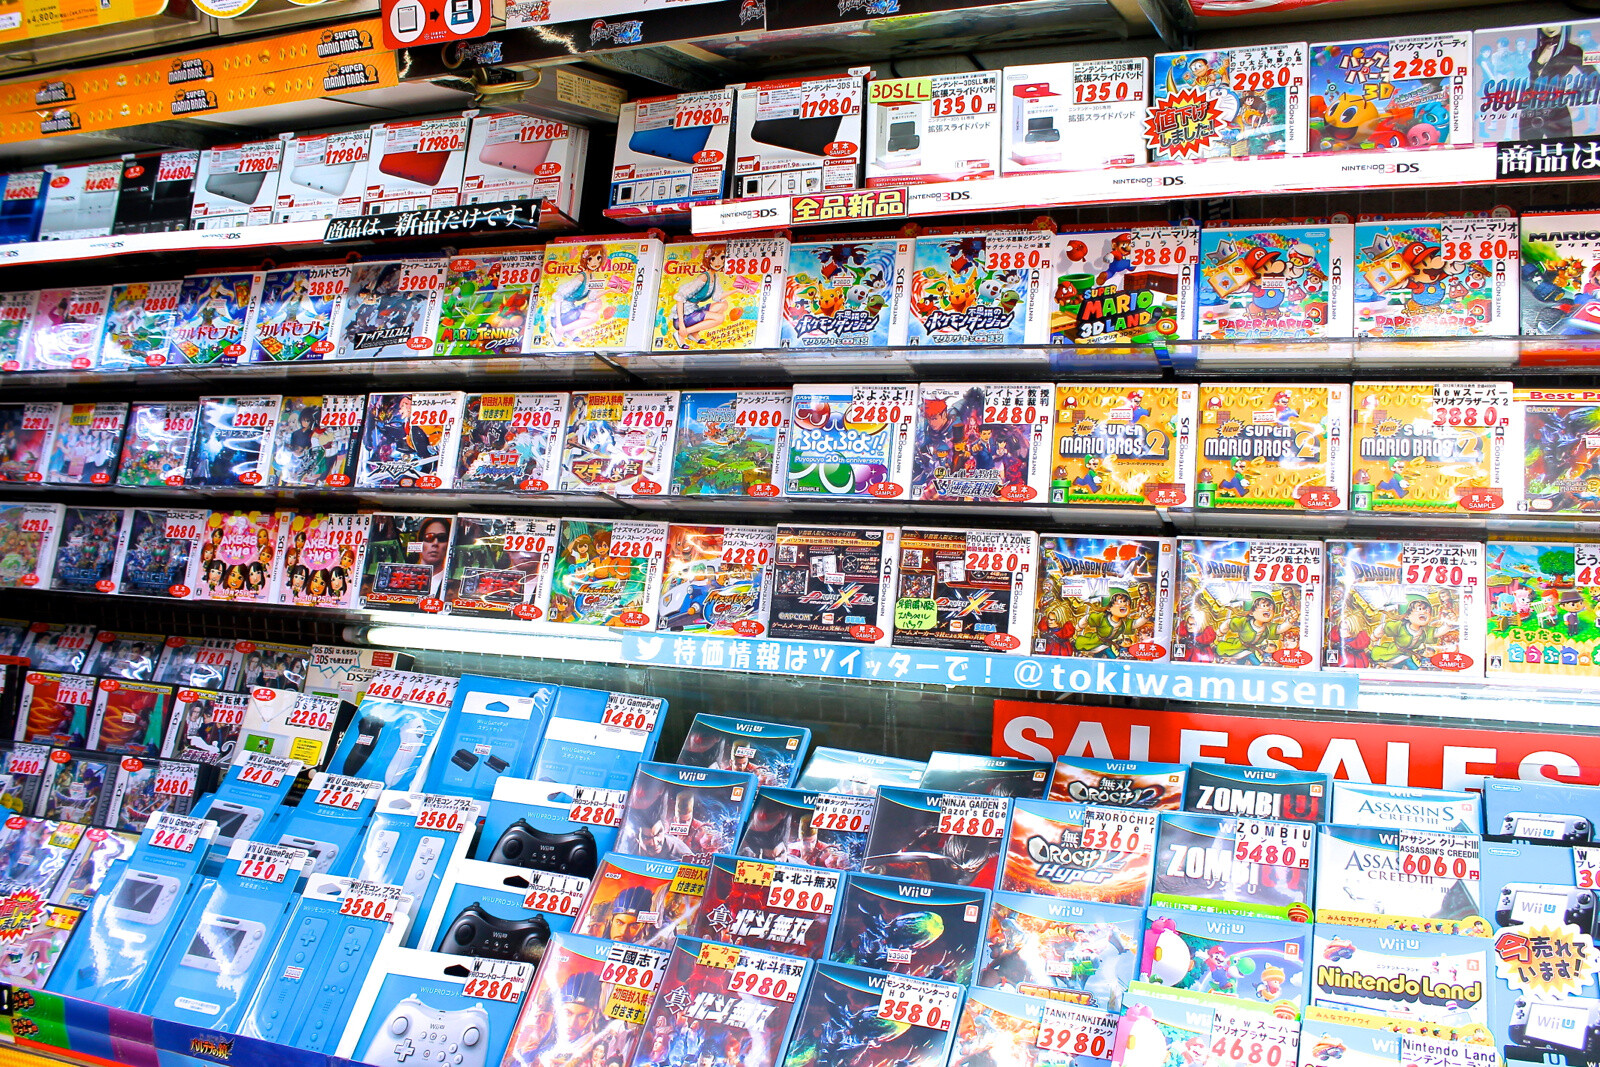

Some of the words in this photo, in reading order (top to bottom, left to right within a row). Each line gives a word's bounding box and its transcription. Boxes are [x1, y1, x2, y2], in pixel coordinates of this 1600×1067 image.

[335, 31, 357, 39] SUPER
[183, 58, 201, 68] SUPER
[341, 64, 363, 72] SUPER
[169, 70, 188, 84] MARIO
[1074, 71, 1143, 83] 拡張スライドパッド
[186, 90, 205, 99] SUPER
[872, 83, 928, 99] 3DSLL
[932, 86, 995, 97] 拡張スライドパッド
[172, 100, 191, 113] MARIO
[1154, 103, 1207, 133] 値下げ
[793, 190, 904, 222] 全品新品
[1132, 230, 1198, 240] スーパーマリオ
[1084, 285, 1116, 300] SUPER
[1083, 290, 1154, 320] MARIO
[441, 327, 477, 342] MARIO
[477, 327, 519, 339] TENNIS
[985, 390, 1050, 399] レイトン教授
[1530, 391, 1575, 399] Best
[1223, 424, 1240, 433] New
[1246, 425, 1291, 437] SUPER
[1205, 438, 1251, 457] MARIO
[967, 534, 1000, 544] PROJECT
[1011, 536, 1031, 544] ZONE
[1249, 546, 1320, 556] ドラゴンクエストVII
[1403, 547, 1477, 557] ドラゴンクエストVII
[1250, 555, 1320, 564] エデンの戦士たち
[974, 623, 996, 632] SEGA
[1513, 629, 1562, 643] とびだせ
[990, 640, 1014, 649] SAMPLE
[1438, 661, 1466, 669] SAMPLE
[1014, 660, 1346, 707] @tokiwamusen
[627, 698, 660, 710] GamePad
[942, 799, 967, 809] NINJA
[969, 800, 1000, 809] GAIDEN
[941, 806, 979, 816] Razor's
[983, 810, 1006, 819] Edge
[1400, 845, 1445, 856] ASSASSIN'S
[1403, 1039, 1458, 1057] Nintendo
[1464, 1048, 1496, 1062] Land
